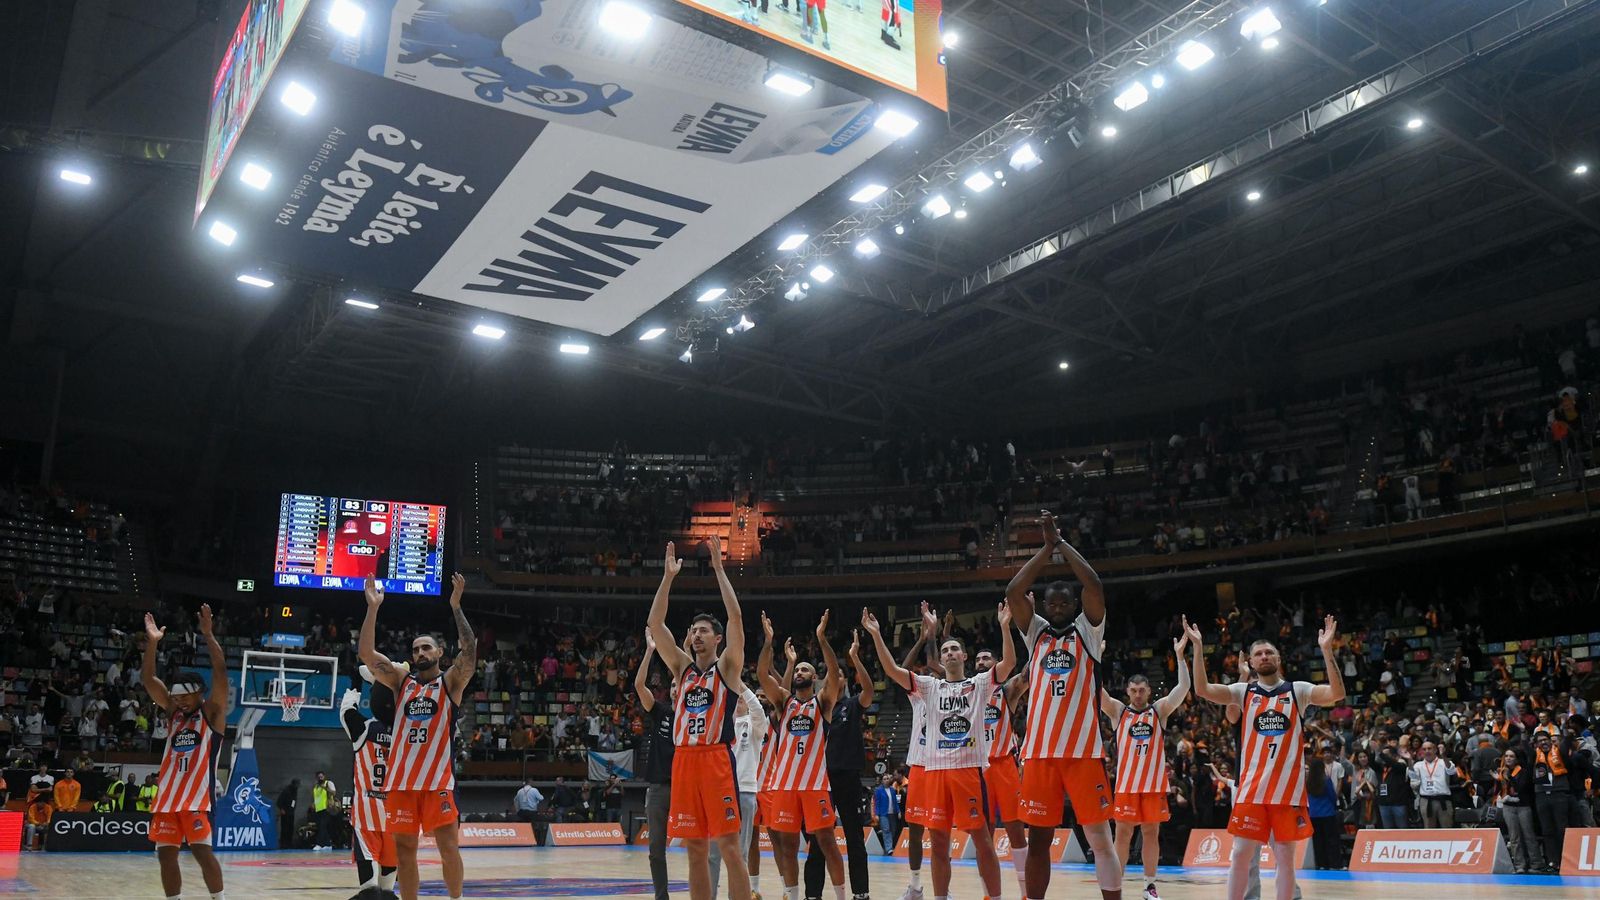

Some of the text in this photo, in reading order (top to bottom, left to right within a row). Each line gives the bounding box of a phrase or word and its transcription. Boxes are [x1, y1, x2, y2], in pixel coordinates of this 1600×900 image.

[676, 102, 767, 154] LEYMA
[291, 173, 318, 200] dende
[302, 148, 405, 233] Leyma
[275, 202, 300, 225] 1962
[349, 191, 439, 247] leite,
[461, 170, 713, 301] LEYMA
[345, 501, 385, 512] 83 90
[351, 546, 372, 554] 0:00
[279, 573, 300, 585] LEYMA
[322, 576, 343, 588] LEYMA
[404, 581, 425, 593] LEYMA
[1047, 660, 1070, 668] Galicia
[1051, 680, 1066, 696] 12
[409, 707, 432, 715] Galicia
[939, 696, 970, 711] LEYMA
[688, 717, 706, 735] 22
[1259, 722, 1284, 730] Galicia
[409, 728, 428, 743] 23
[797, 741, 804, 755] 6
[1135, 743, 1149, 756] 77
[1268, 743, 1278, 760] 7
[178, 757, 188, 772] 11
[876, 763, 884, 773] 7
[373, 764, 386, 787] 9
[54, 816, 150, 835] endesa
[216, 827, 267, 847] LEYMA
[1361, 840, 1443, 863] Grupo Aluman
